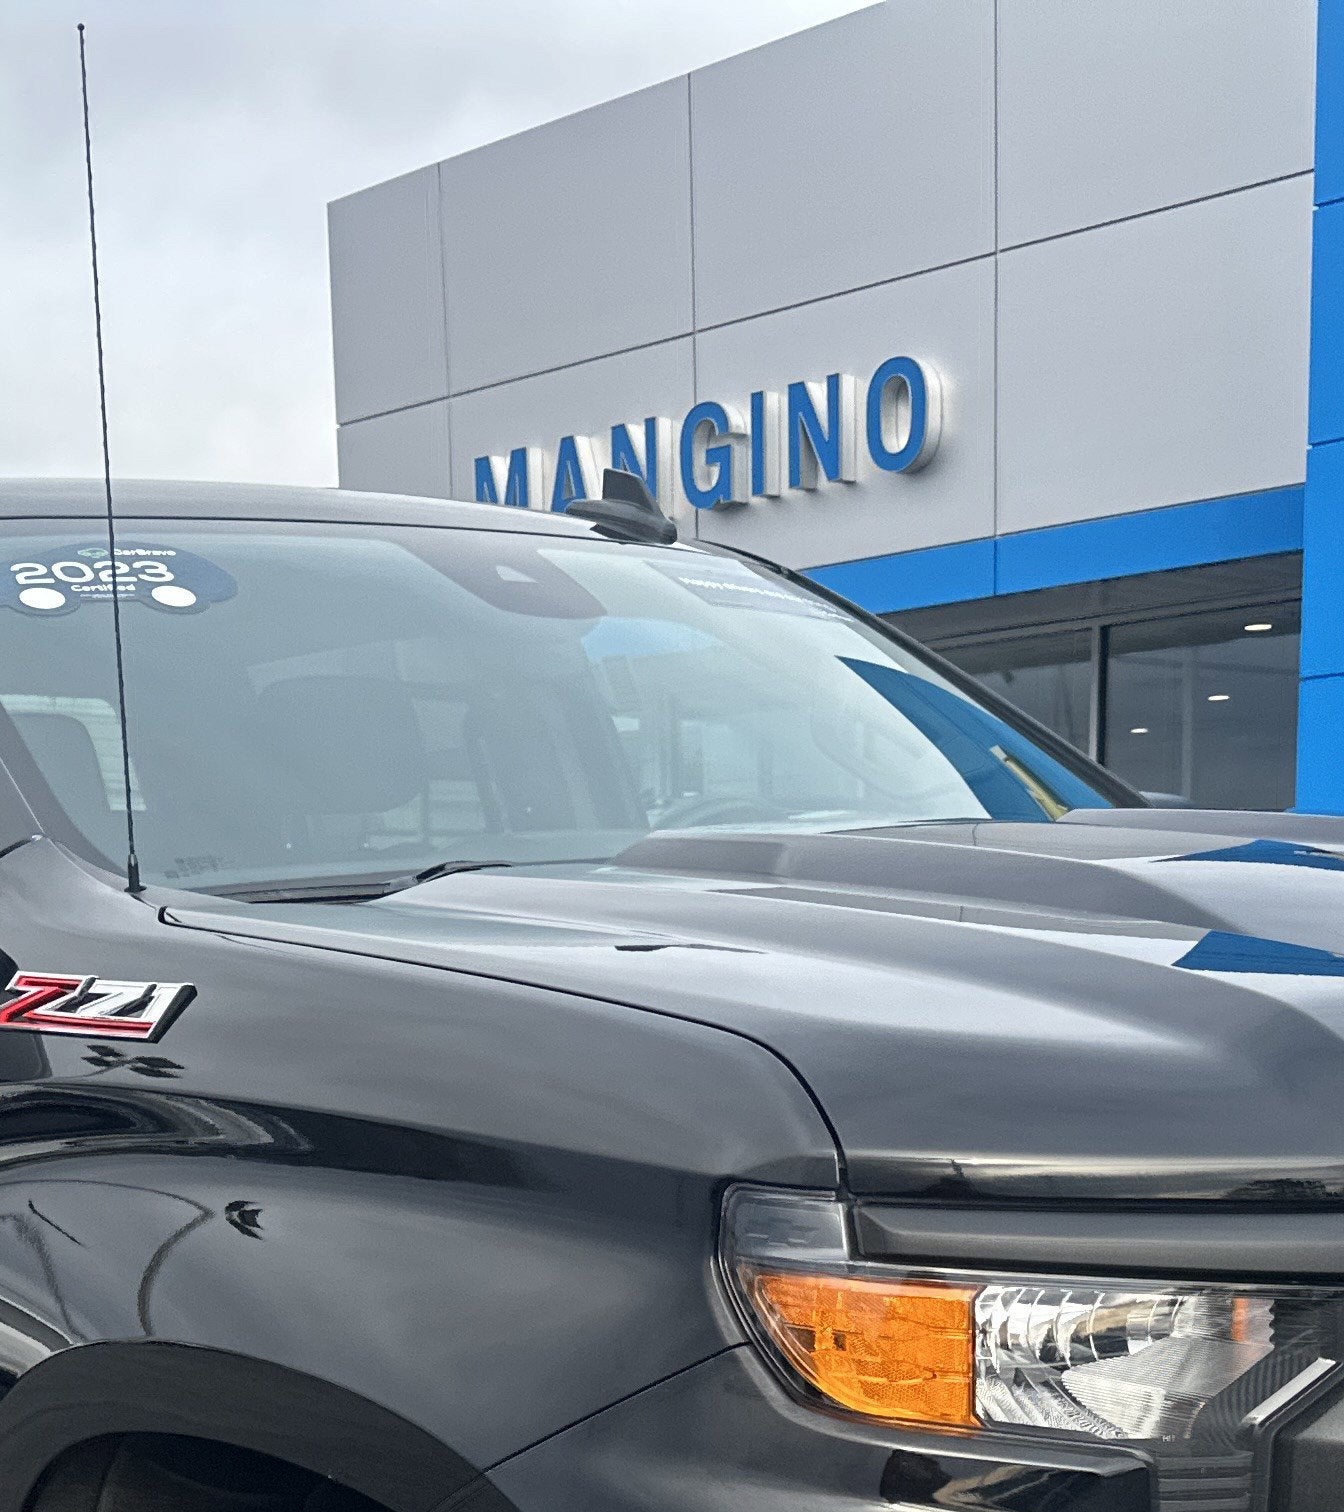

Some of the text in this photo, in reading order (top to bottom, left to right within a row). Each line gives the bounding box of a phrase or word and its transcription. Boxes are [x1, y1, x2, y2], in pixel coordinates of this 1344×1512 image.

[474, 356, 930, 512] MANGINO
[10, 560, 175, 585] 2023
[70, 584, 136, 592] Certifed
